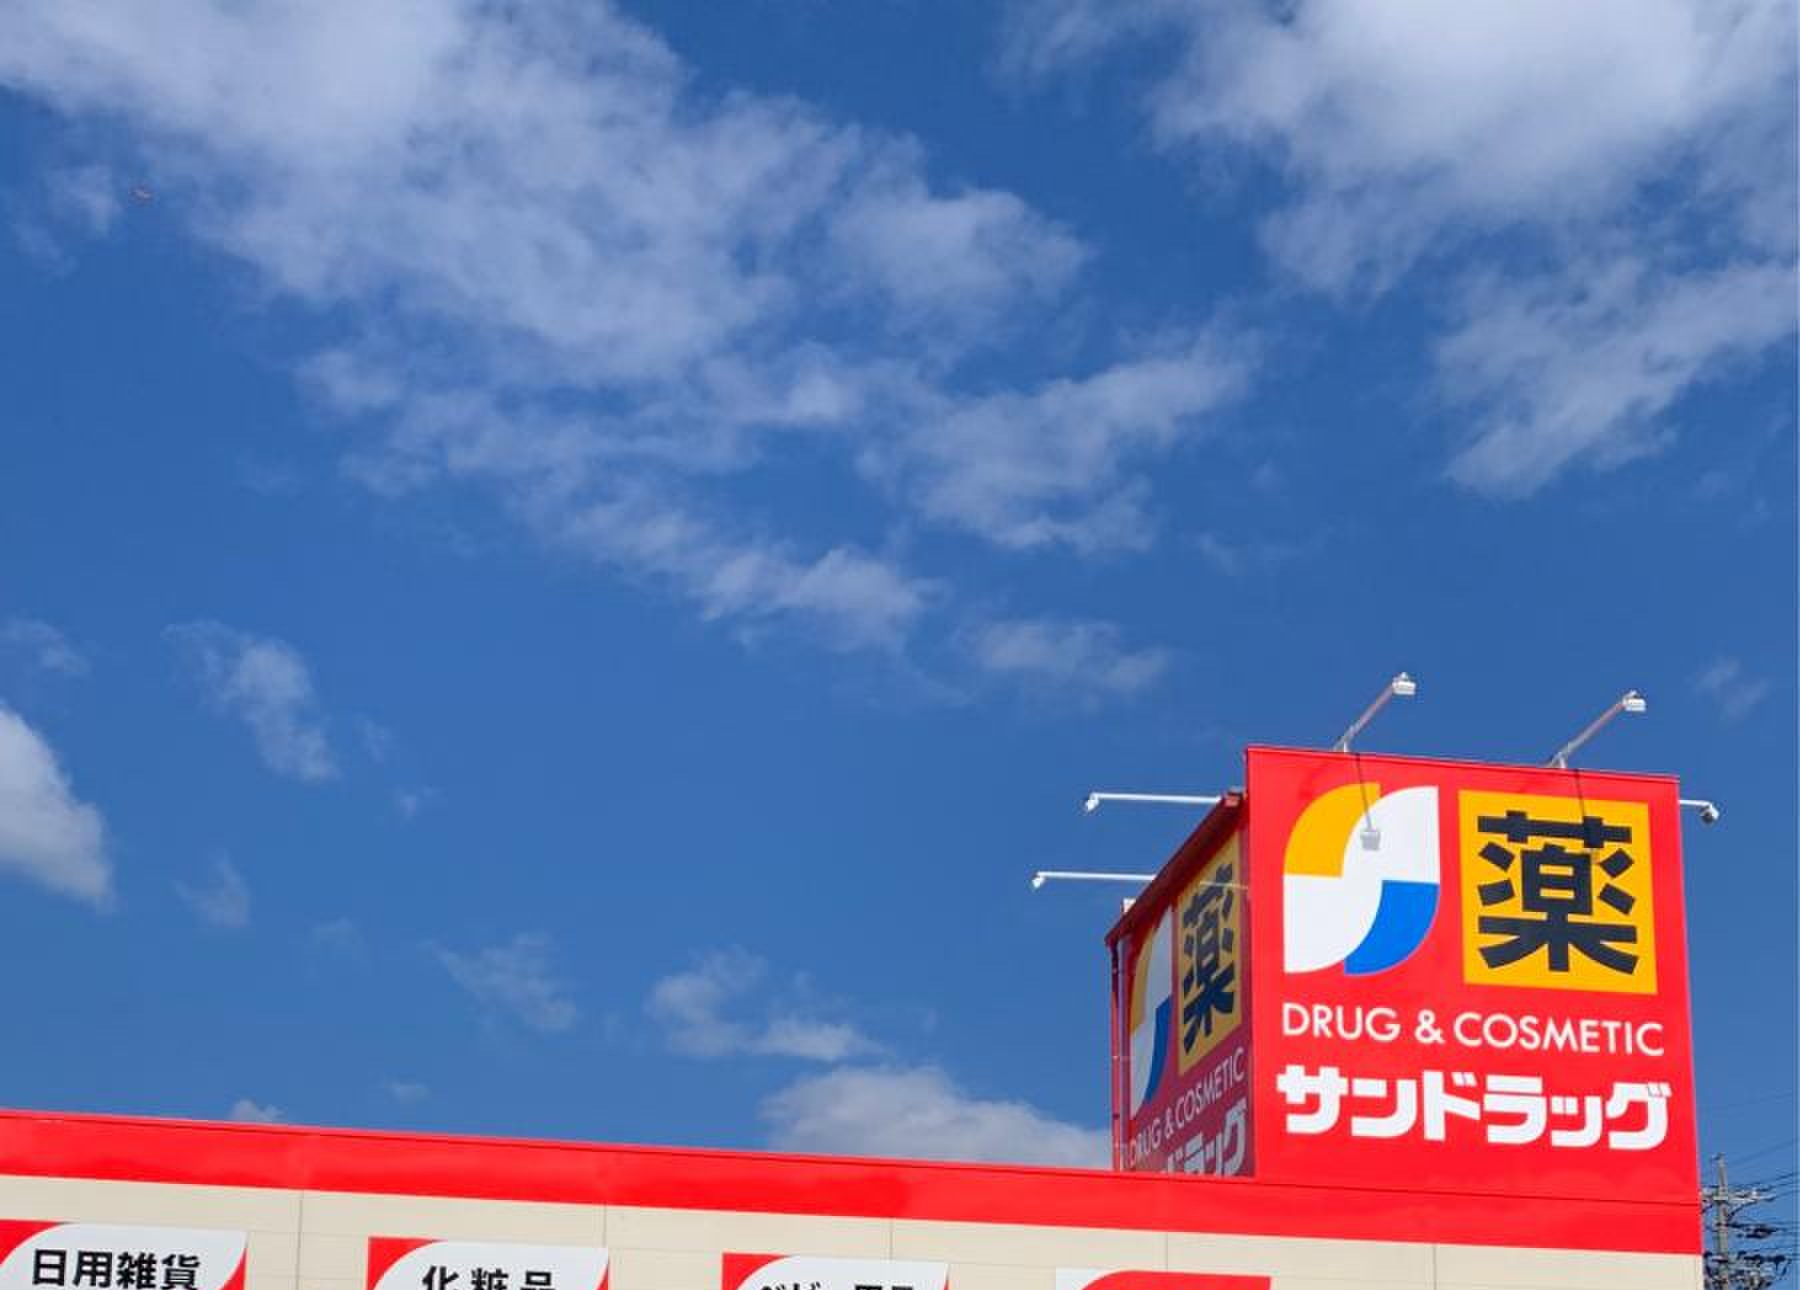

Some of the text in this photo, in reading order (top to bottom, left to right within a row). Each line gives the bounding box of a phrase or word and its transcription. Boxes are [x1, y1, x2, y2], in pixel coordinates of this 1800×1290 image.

[1477, 811, 1639, 975] 薬
[1182, 863, 1234, 1055] 薬
[1282, 1002, 1665, 1056] DRUG & COSMETIC
[1129, 1046, 1245, 1168] DRUG & COSMETIC
[1276, 1064, 1672, 1151] サンドラッグ
